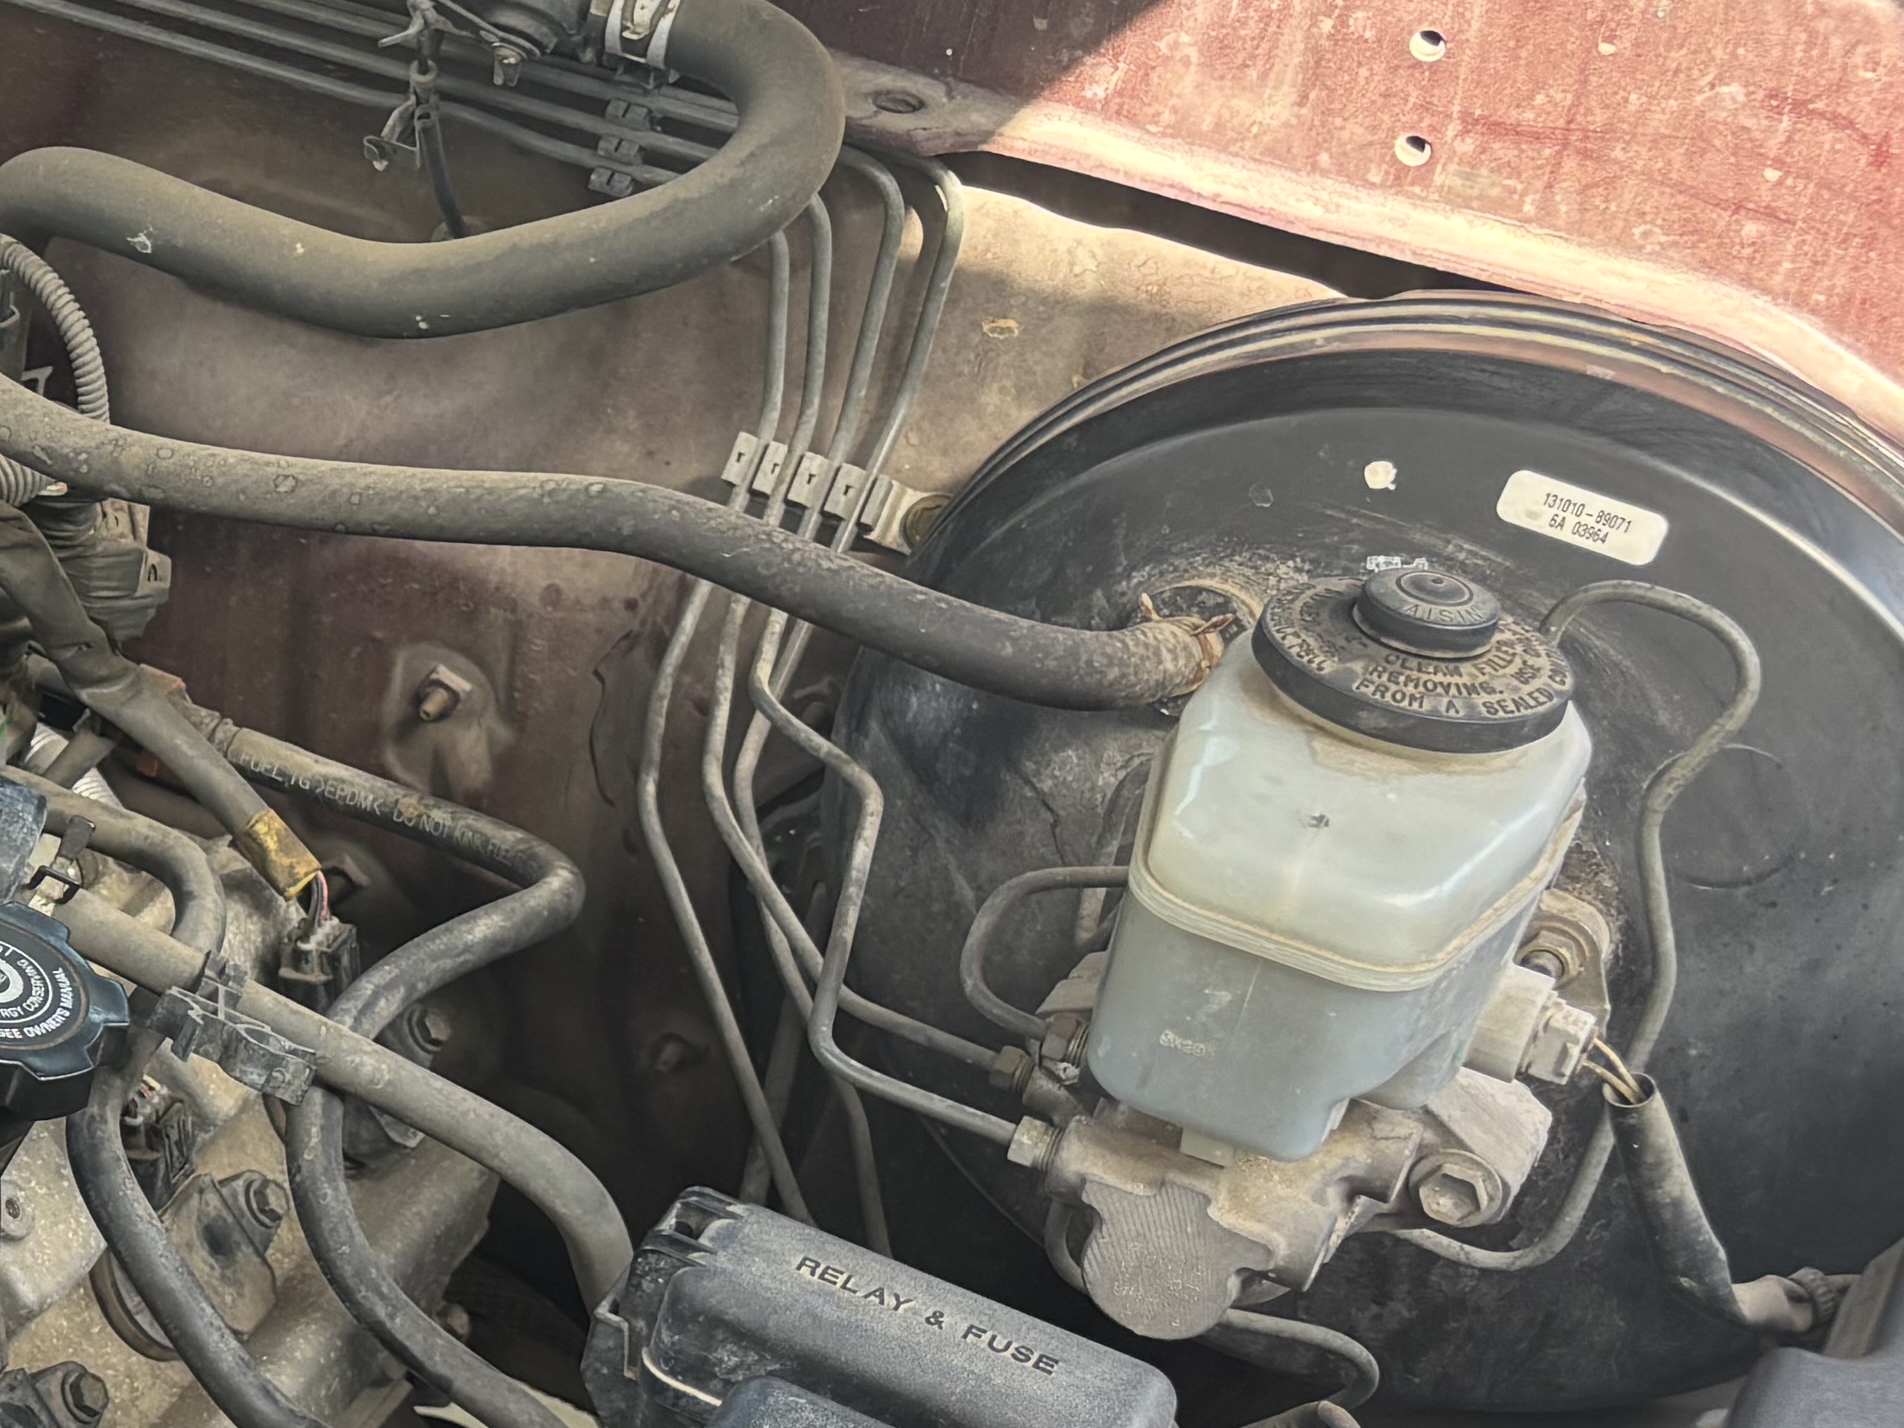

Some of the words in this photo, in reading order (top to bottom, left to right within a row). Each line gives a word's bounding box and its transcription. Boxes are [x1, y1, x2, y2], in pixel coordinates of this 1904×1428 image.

[1572, 521, 1610, 545] 03964
[1401, 603, 1484, 623] AISIN
[1355, 678, 1426, 709] FROM
[1445, 699, 1462, 715] A
[1481, 686, 1554, 717] SEALED
[419, 817, 449, 837] NOT
[52, 967, 74, 1009] MANUAL
[795, 1256, 914, 1312] RELAY
[924, 1310, 945, 1330] &
[961, 1324, 1060, 1376] FUSE
